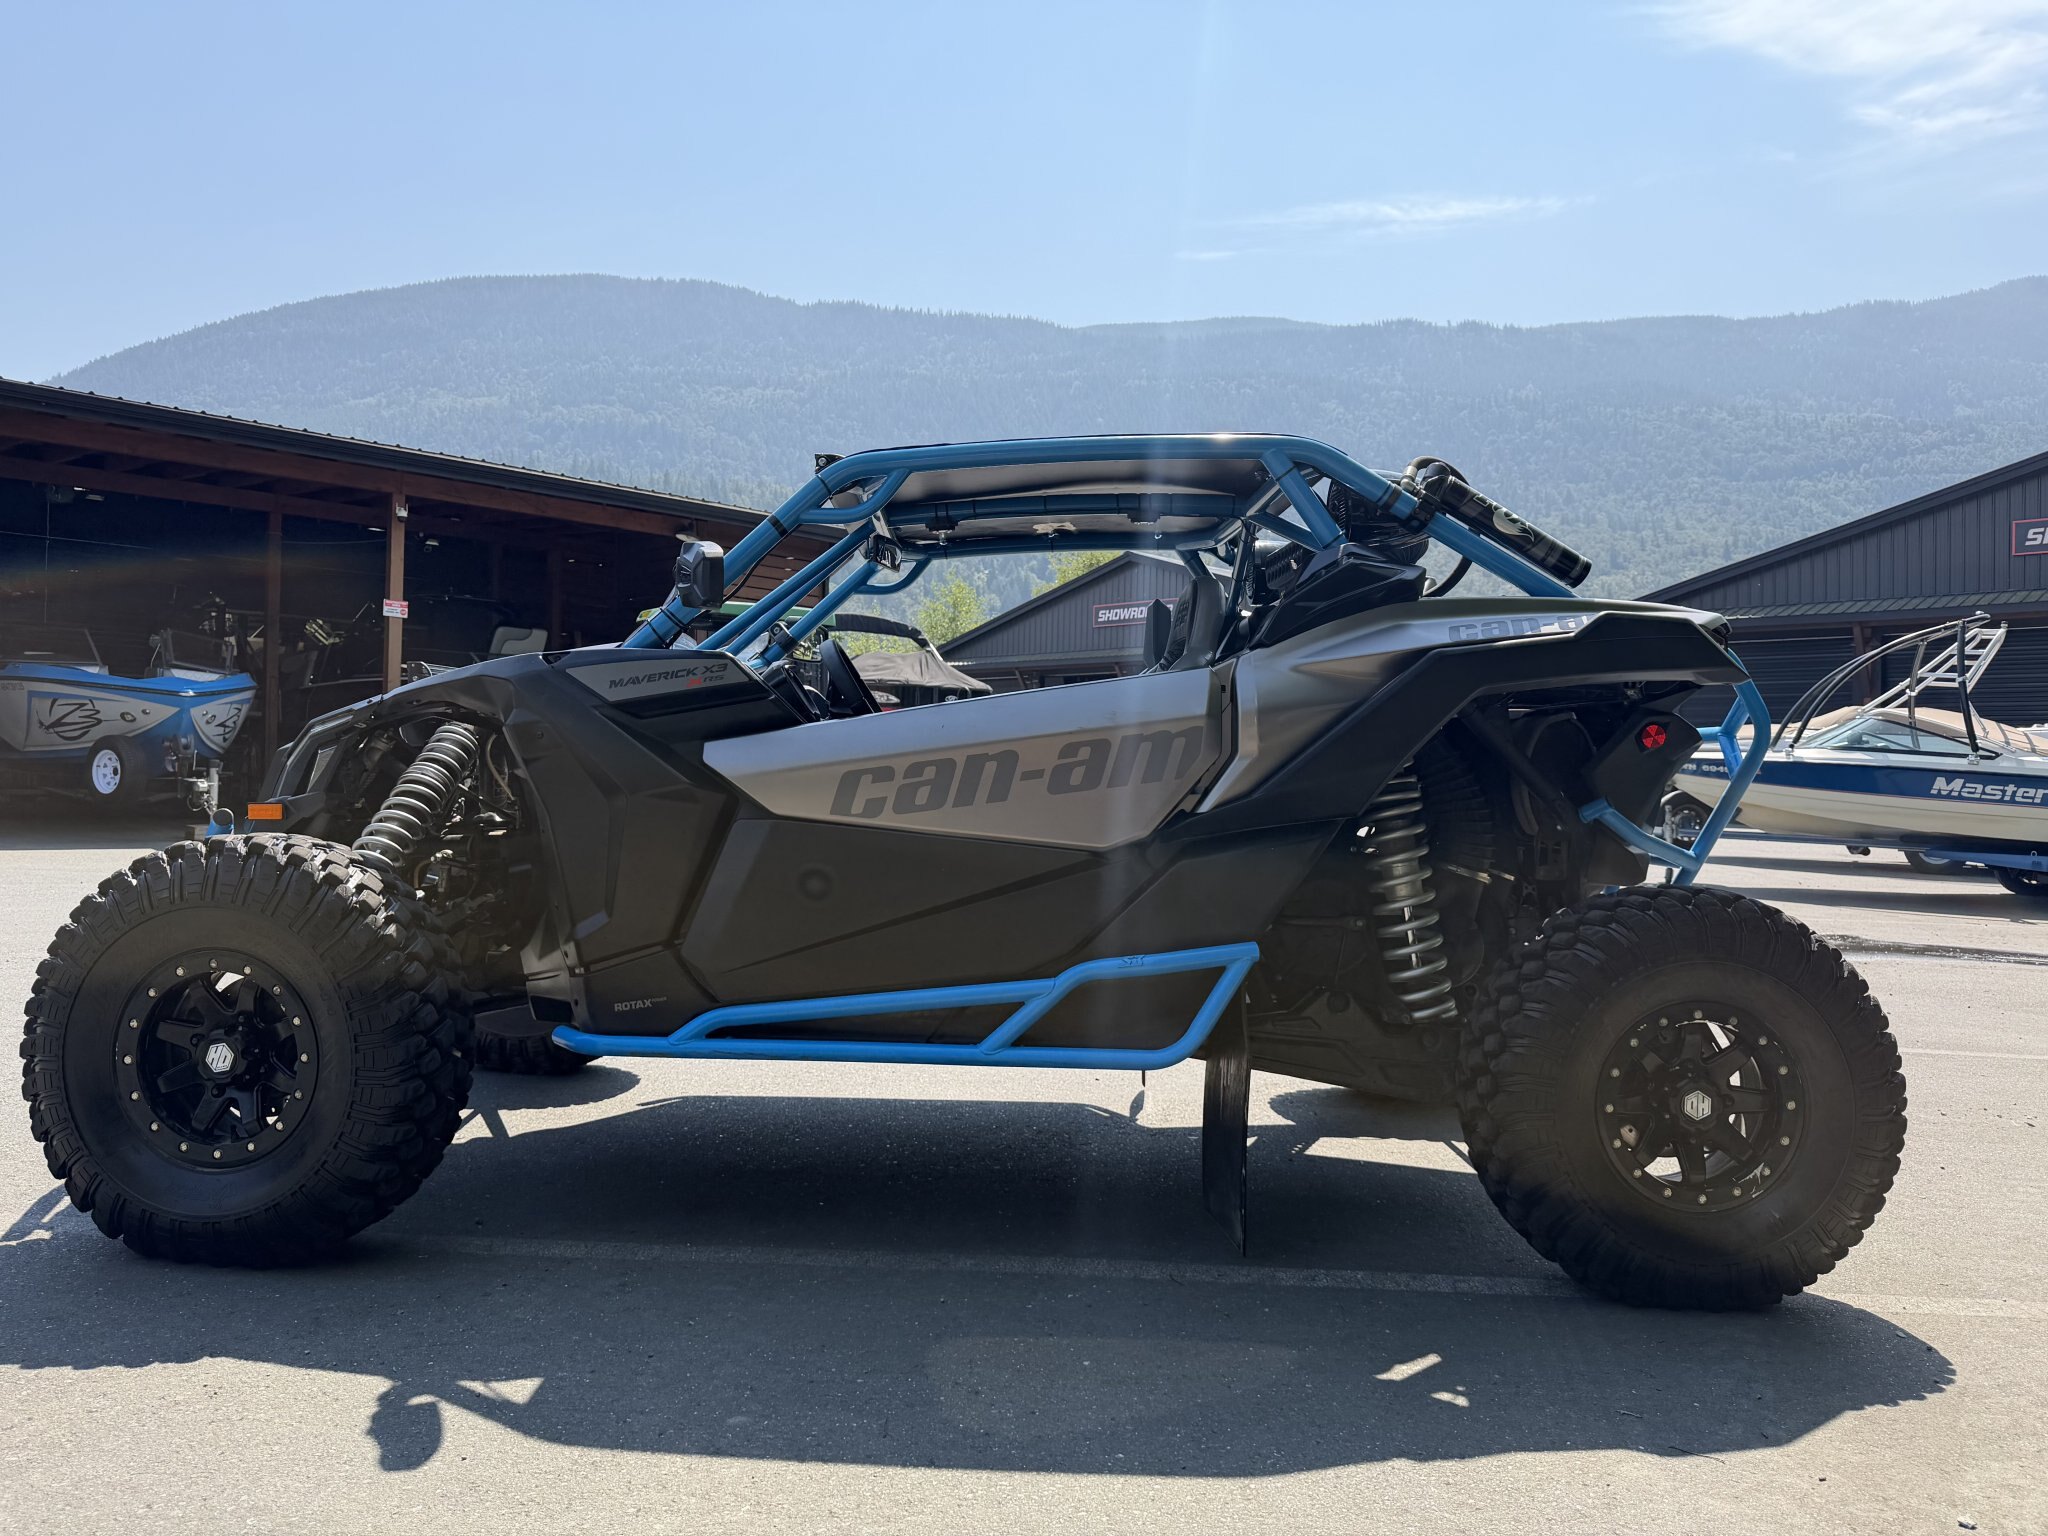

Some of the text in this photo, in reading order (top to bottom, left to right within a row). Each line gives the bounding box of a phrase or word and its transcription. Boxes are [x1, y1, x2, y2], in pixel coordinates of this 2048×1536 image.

[1448, 615, 1592, 642] can-a
[608, 663, 729, 689] MAVERICK X3
[829, 725, 1205, 819] can-am
[614, 999, 653, 1012] ROTAX
